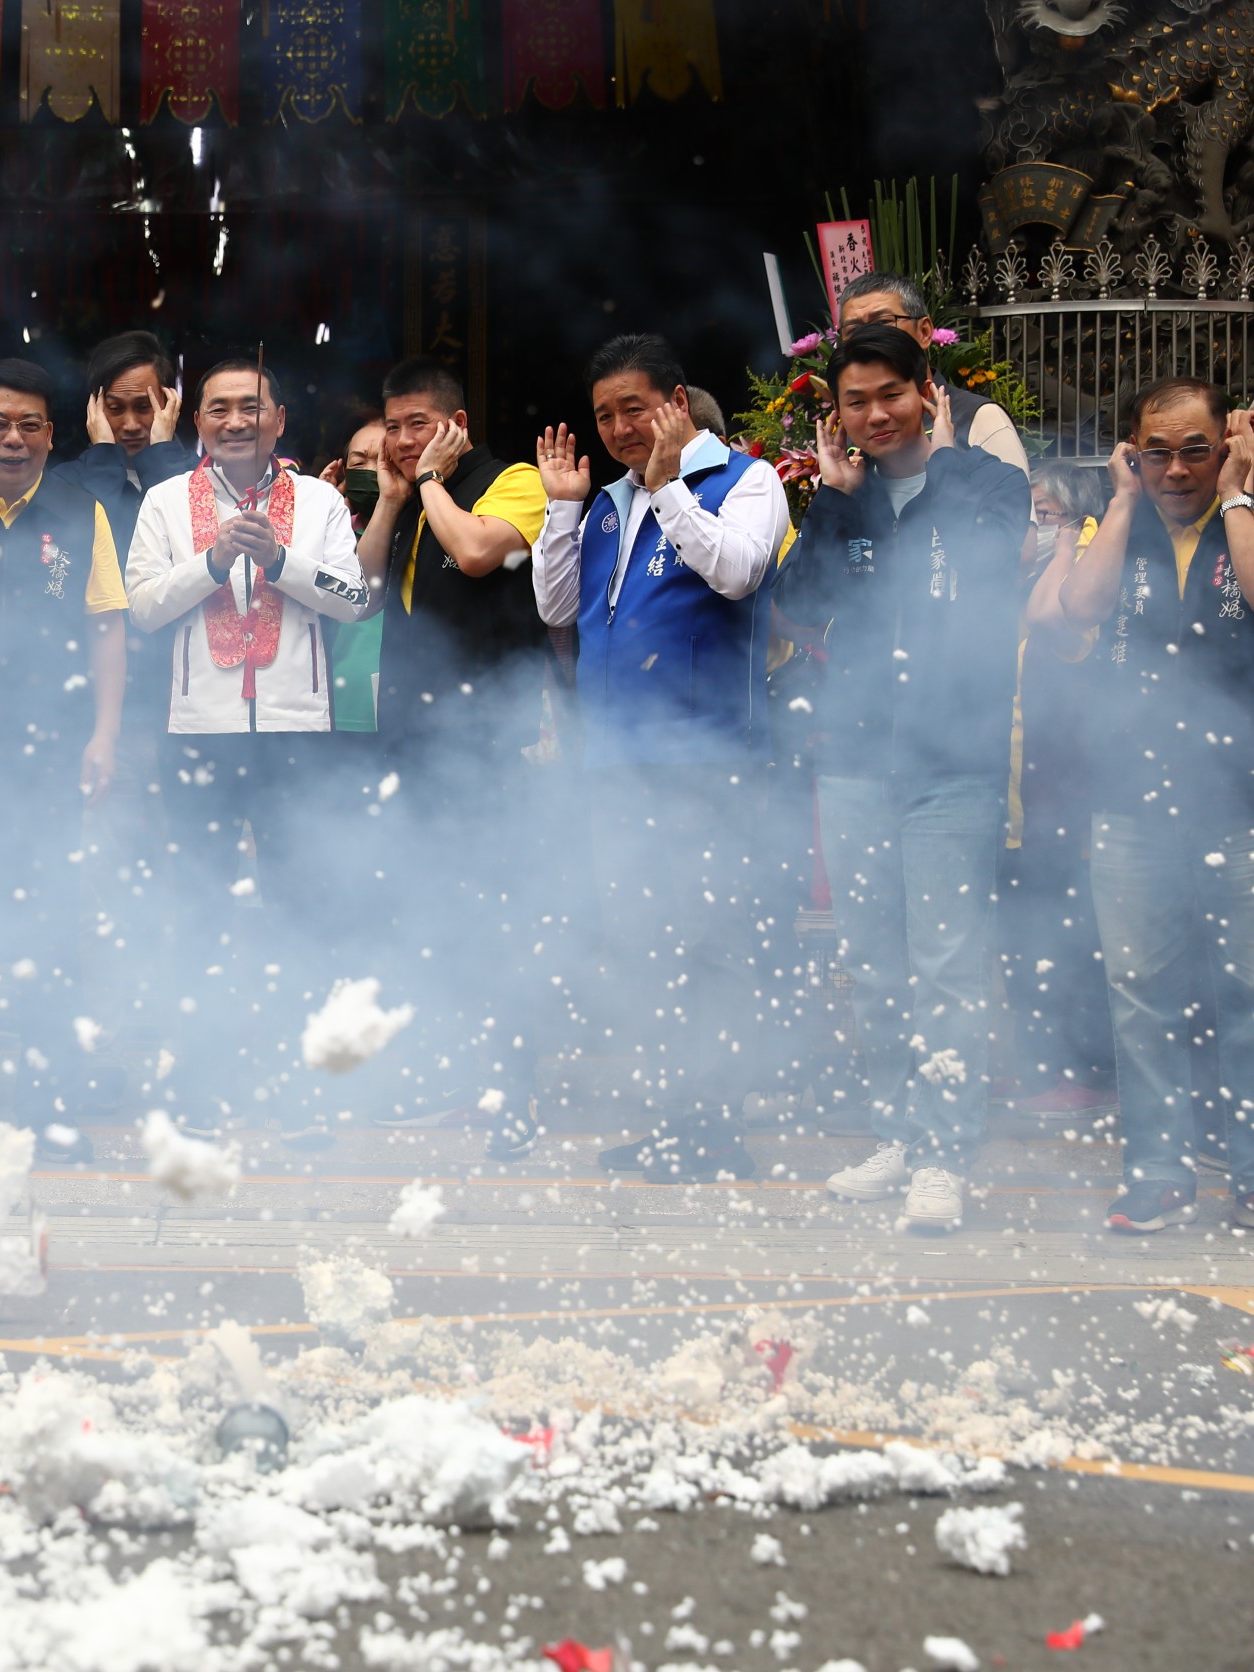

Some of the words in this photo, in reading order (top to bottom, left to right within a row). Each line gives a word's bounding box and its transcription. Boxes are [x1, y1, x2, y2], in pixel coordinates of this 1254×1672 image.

[846, 232, 862, 273] 香火
[45, 547, 71, 600] 板橋媽
[1133, 557, 1148, 616] 管理委員
